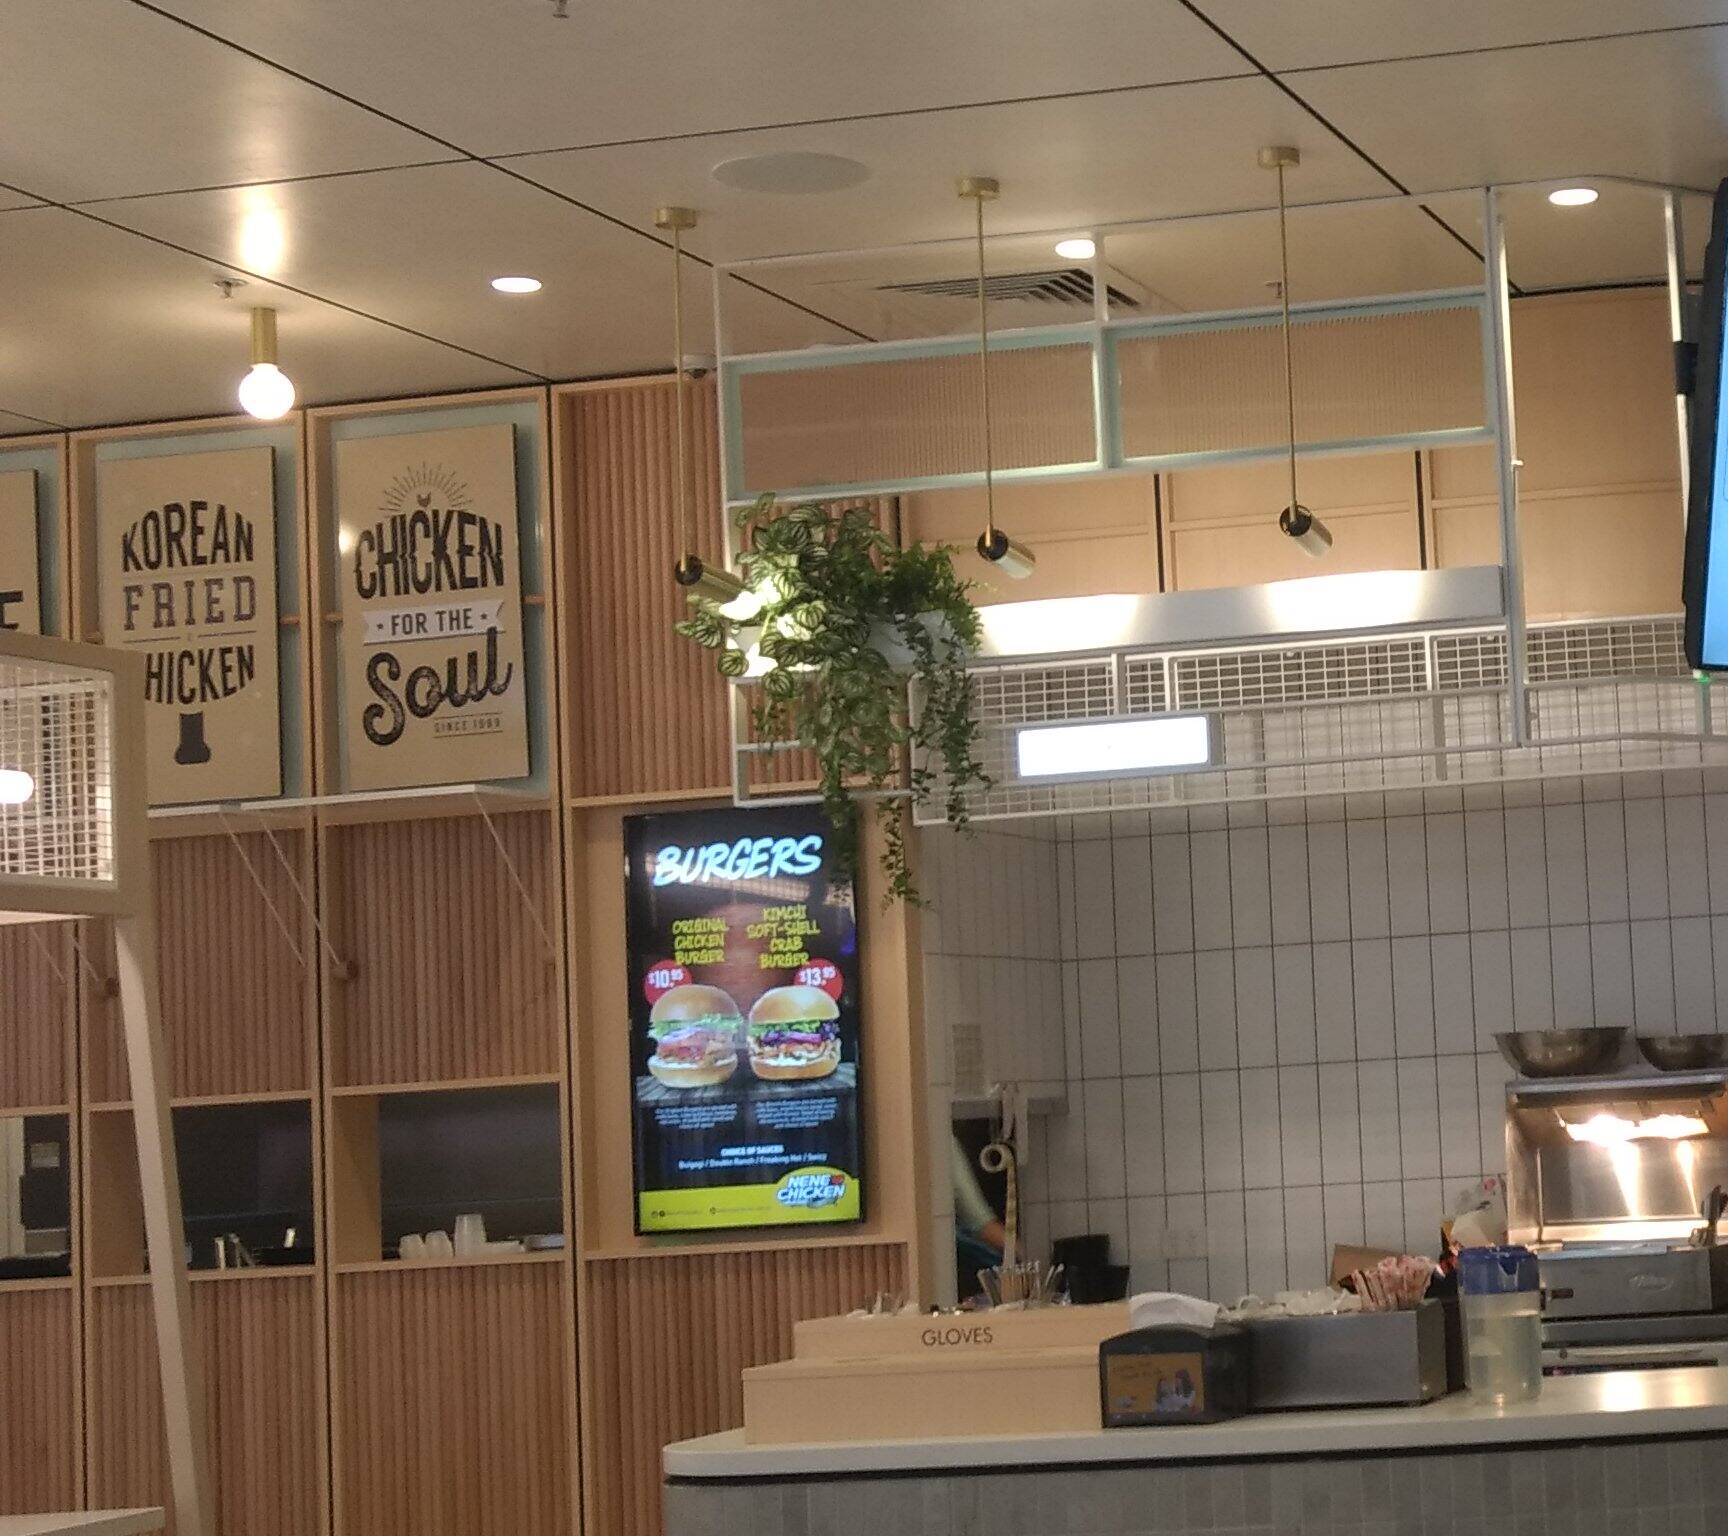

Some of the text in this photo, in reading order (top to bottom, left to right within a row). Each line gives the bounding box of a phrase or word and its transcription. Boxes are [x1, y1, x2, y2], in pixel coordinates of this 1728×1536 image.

[121, 500, 255, 573] KOREAN
[353, 509, 505, 599] CHICKEN
[123, 575, 257, 631] FRIED
[391, 607, 473, 636] FOR THE
[145, 644, 255, 706] HICKEN
[363, 626, 512, 746] Soul
[653, 834, 823, 886] BURGERS
[672, 917, 729, 935] ORIGINAL
[674, 933, 725, 950] CHICKEN
[769, 937, 803, 953] CRAB
[674, 948, 725, 966] BURGER
[759, 951, 809, 969] BURGER
[787, 1174, 831, 1187] NENE
[776, 1184, 846, 1201] CHICKEN
[921, 1326, 993, 1346] GLOVES
